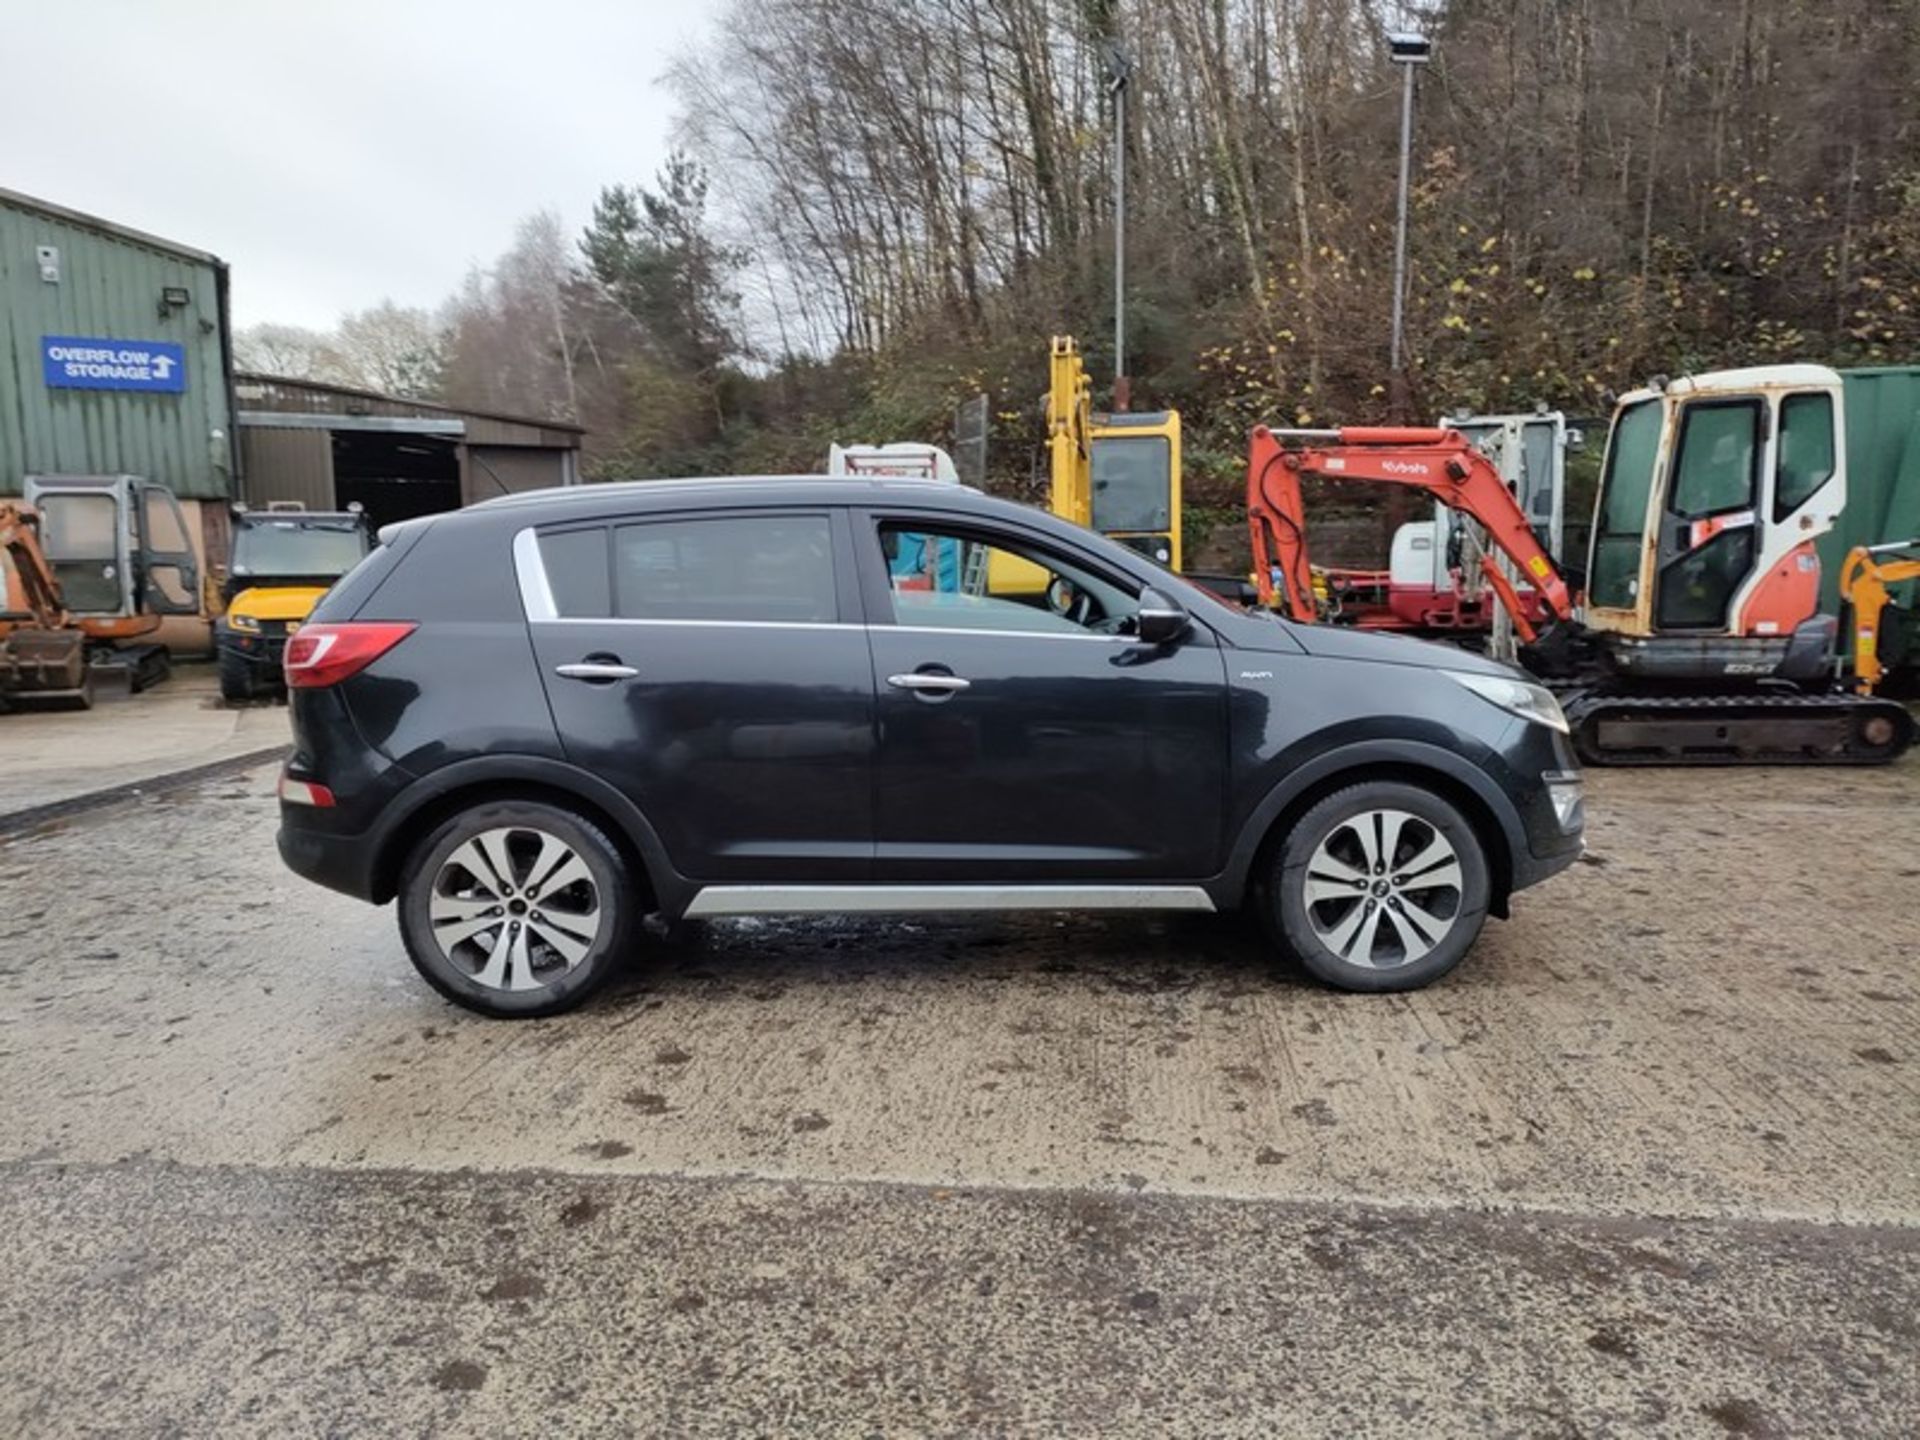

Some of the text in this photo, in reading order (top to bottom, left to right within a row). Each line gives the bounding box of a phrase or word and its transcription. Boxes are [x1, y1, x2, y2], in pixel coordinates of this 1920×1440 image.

[48, 347, 150, 364] OVERFLOW
[64, 362, 152, 380] STORAGE
[1381, 460, 1429, 475] Kubota
